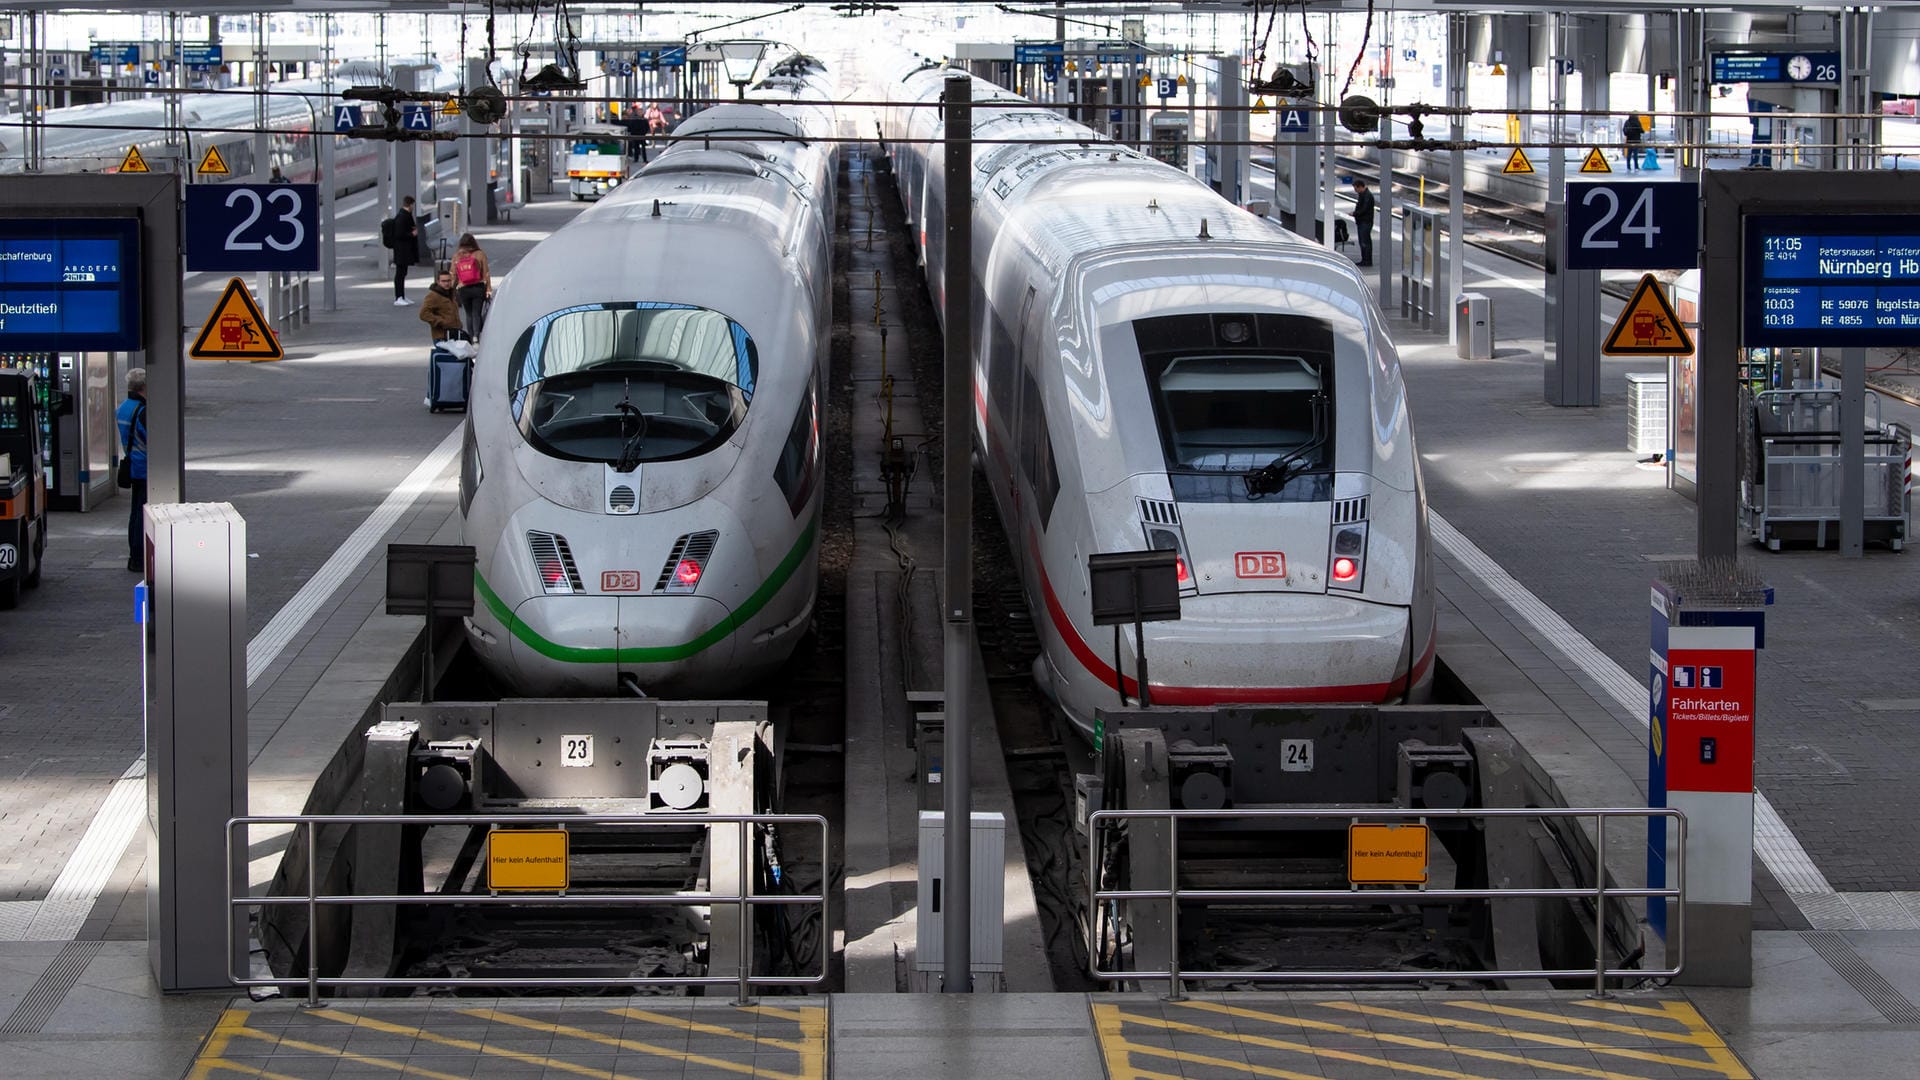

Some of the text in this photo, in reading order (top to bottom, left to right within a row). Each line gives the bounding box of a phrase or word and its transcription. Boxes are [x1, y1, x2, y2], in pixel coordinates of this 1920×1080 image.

[1816, 65, 1836, 80] 26
[1160, 80, 1170, 94] B
[337, 107, 353, 127] A
[411, 107, 427, 127] A
[1285, 110, 1301, 126] A
[225, 188, 305, 252] 23
[1581, 187, 1660, 249] 24
[1766, 238, 1802, 250] 11:05
[1765, 252, 1774, 260] RE
[1819, 259, 1919, 278] Nürnberg Hb
[1764, 298, 1795, 310] 10:03
[1821, 300, 1834, 309] RE
[1838, 300, 1869, 309] 59076
[1764, 314, 1795, 325] 10:18
[1821, 316, 1834, 325] RE
[1838, 316, 1863, 325] 4855
[1876, 317, 1896, 325] von
[0, 548, 14, 564] 20
[1242, 556, 1280, 574] DB
[605, 573, 636, 589] DB
[1672, 697, 1740, 711] Fahrkarten
[1672, 712, 1749, 722] Tickets/Billets/Biglietti
[568, 739, 587, 759] 23
[1288, 743, 1308, 763] 24
